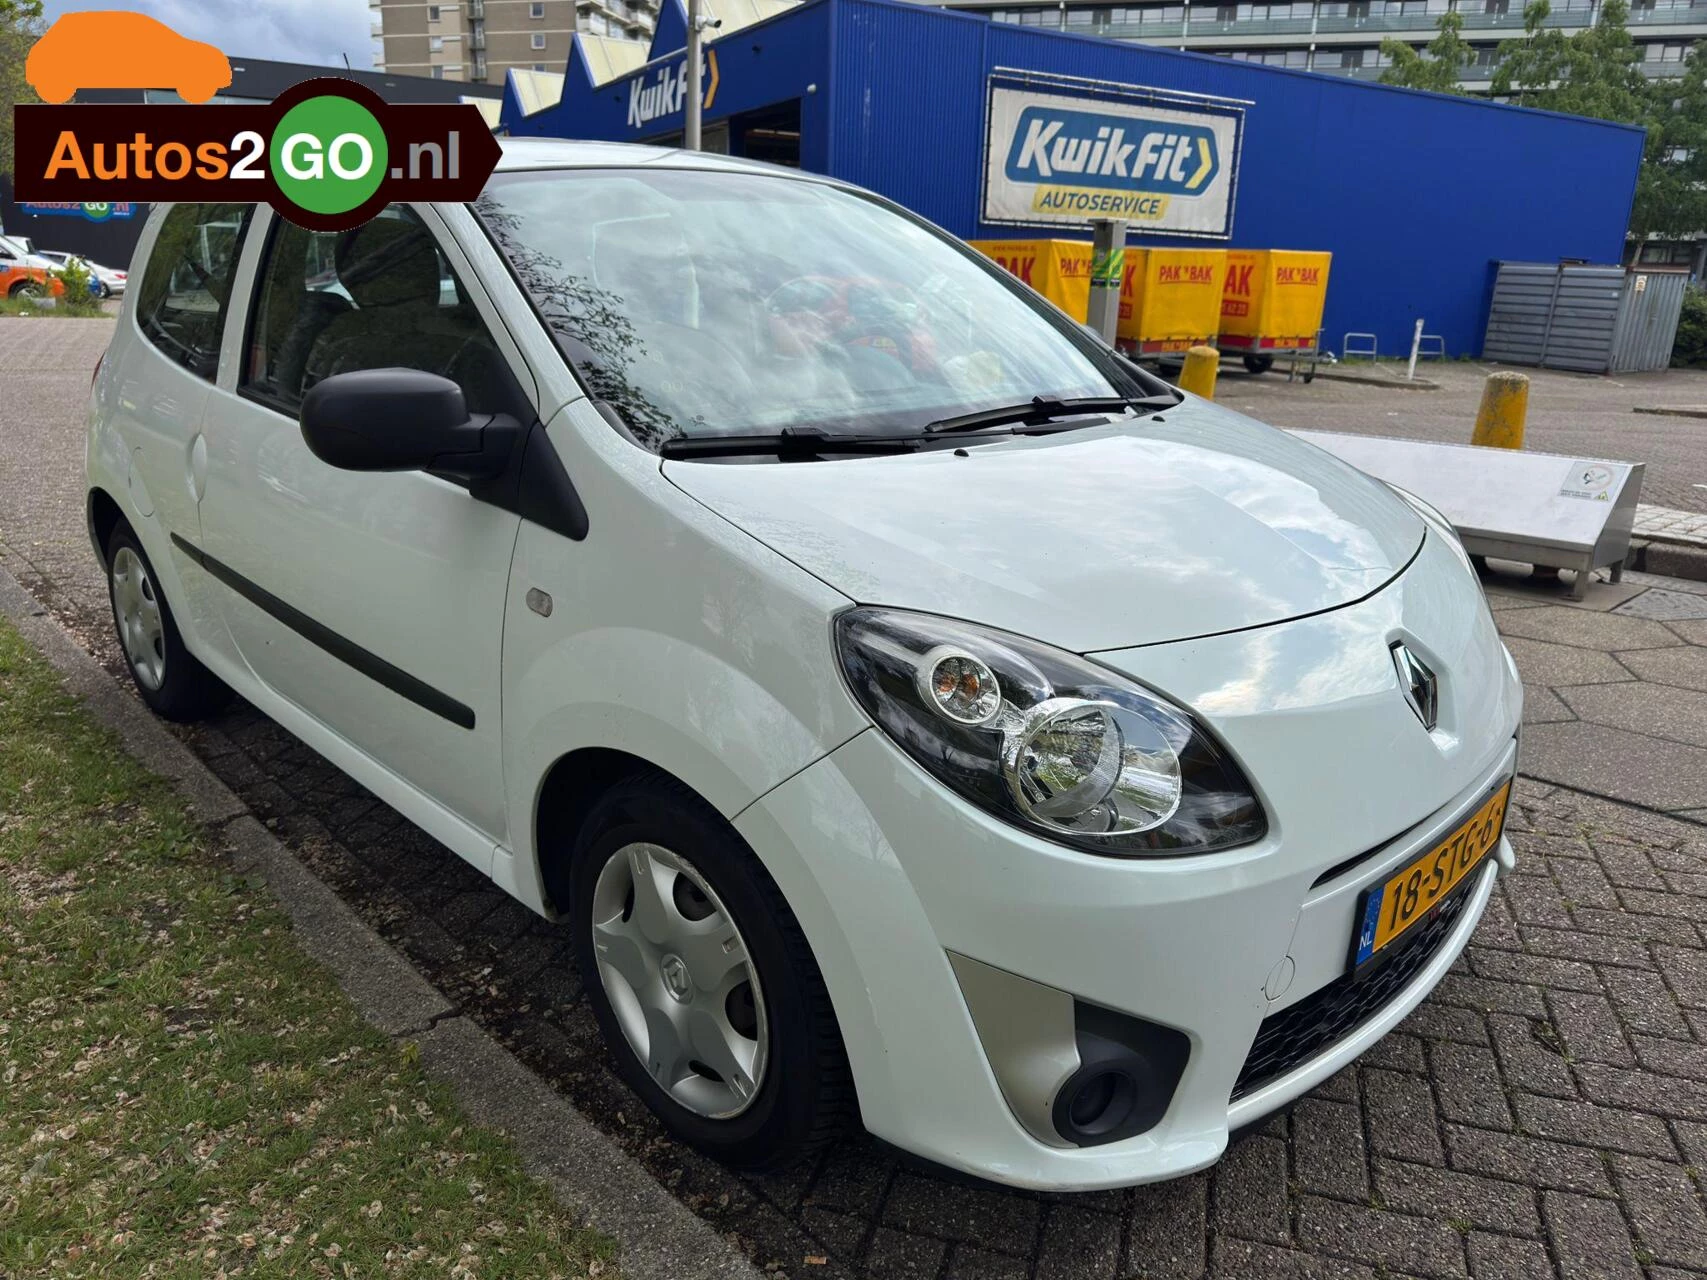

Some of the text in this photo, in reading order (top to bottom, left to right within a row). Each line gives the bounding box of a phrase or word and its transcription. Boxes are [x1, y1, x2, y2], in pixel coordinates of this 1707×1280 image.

[1040, 191, 1161, 215] AUTOSERVICE
[1061, 258, 1080, 275] PAK
[1159, 265, 1181, 281] PAK
[1190, 265, 1214, 281] BAK
[1277, 267, 1294, 281] PAK
[1359, 933, 1373, 951] NL
